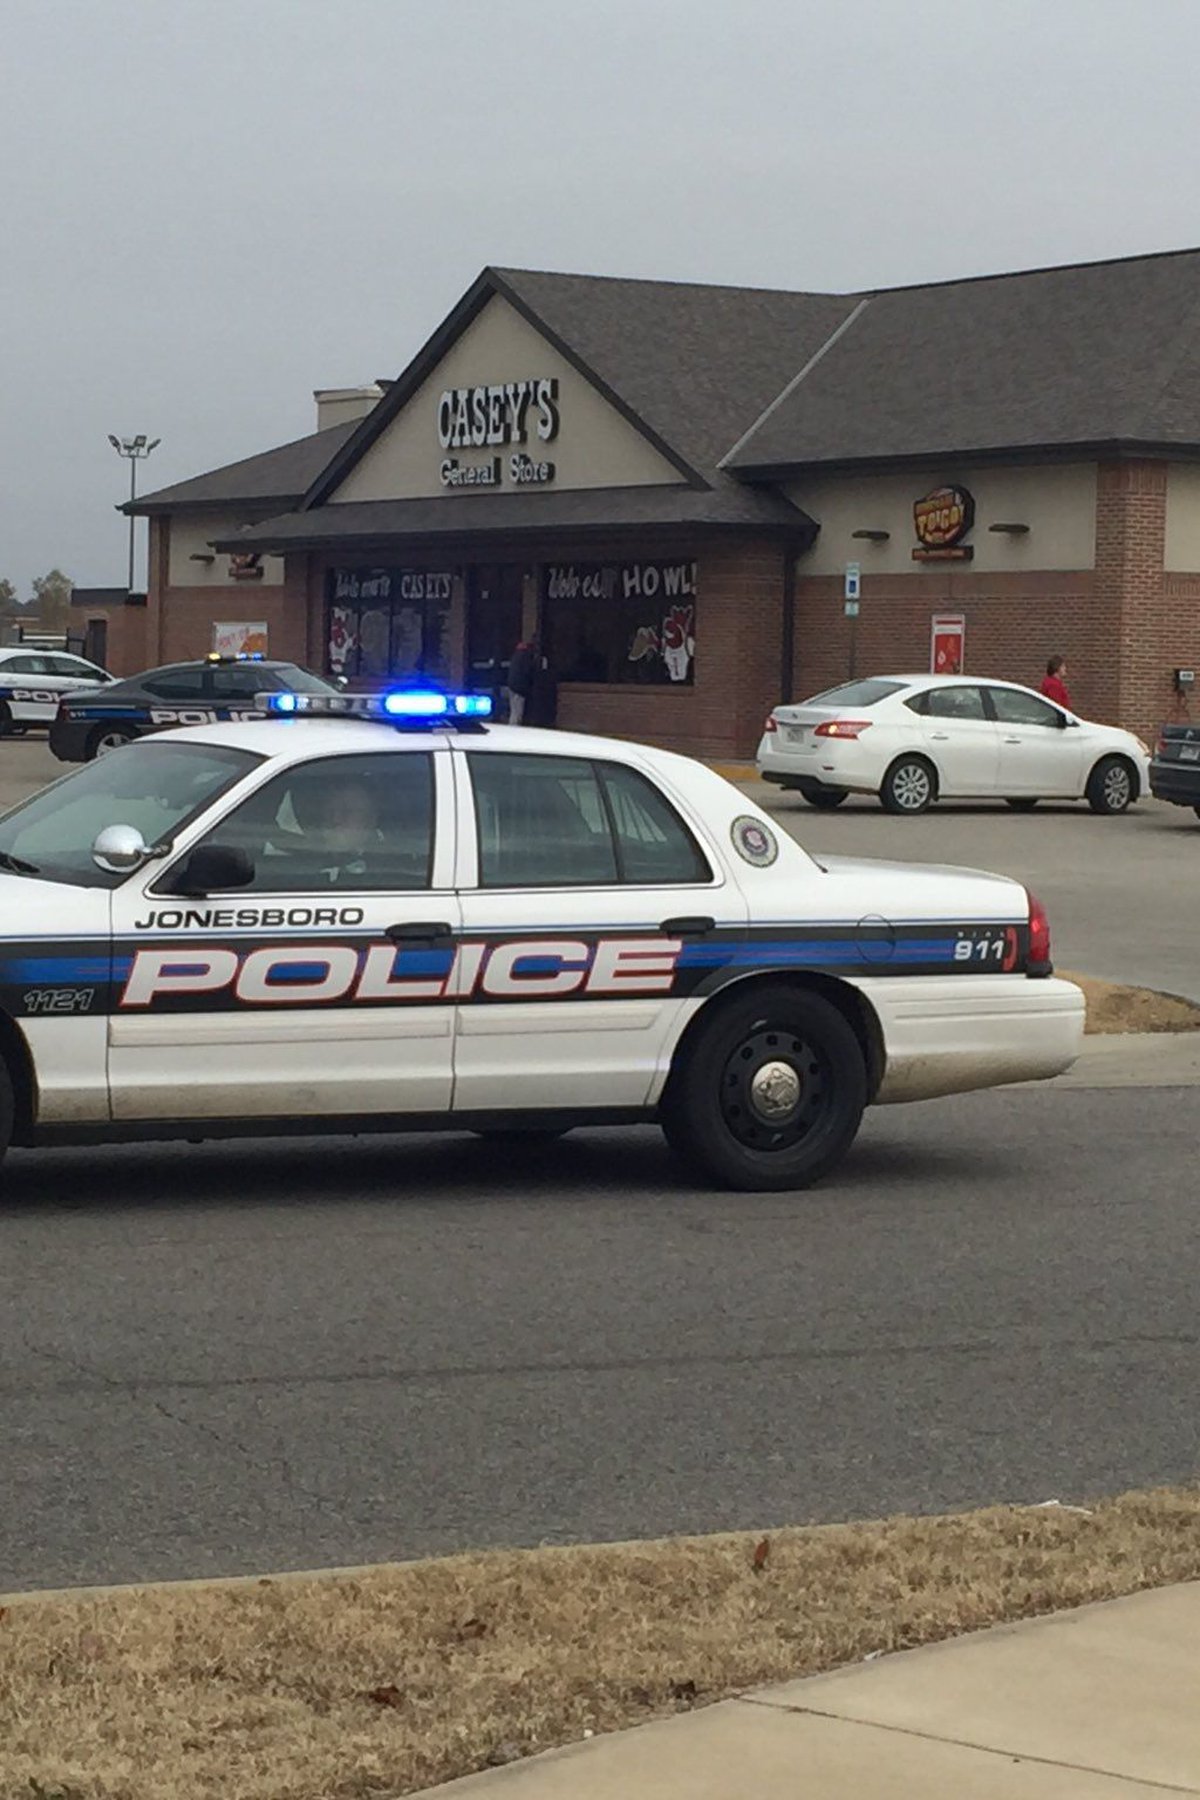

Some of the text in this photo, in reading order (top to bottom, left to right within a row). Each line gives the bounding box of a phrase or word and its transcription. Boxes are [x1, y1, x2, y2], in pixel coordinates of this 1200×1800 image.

[439, 379, 557, 448] CASEY'S
[440, 454, 553, 486] General Store
[149, 710, 267, 725] POLIC
[134, 907, 365, 929] JONESBORO
[954, 940, 1005, 960] 911
[119, 936, 684, 1007] POLICE
[23, 988, 95, 1012] 1121
